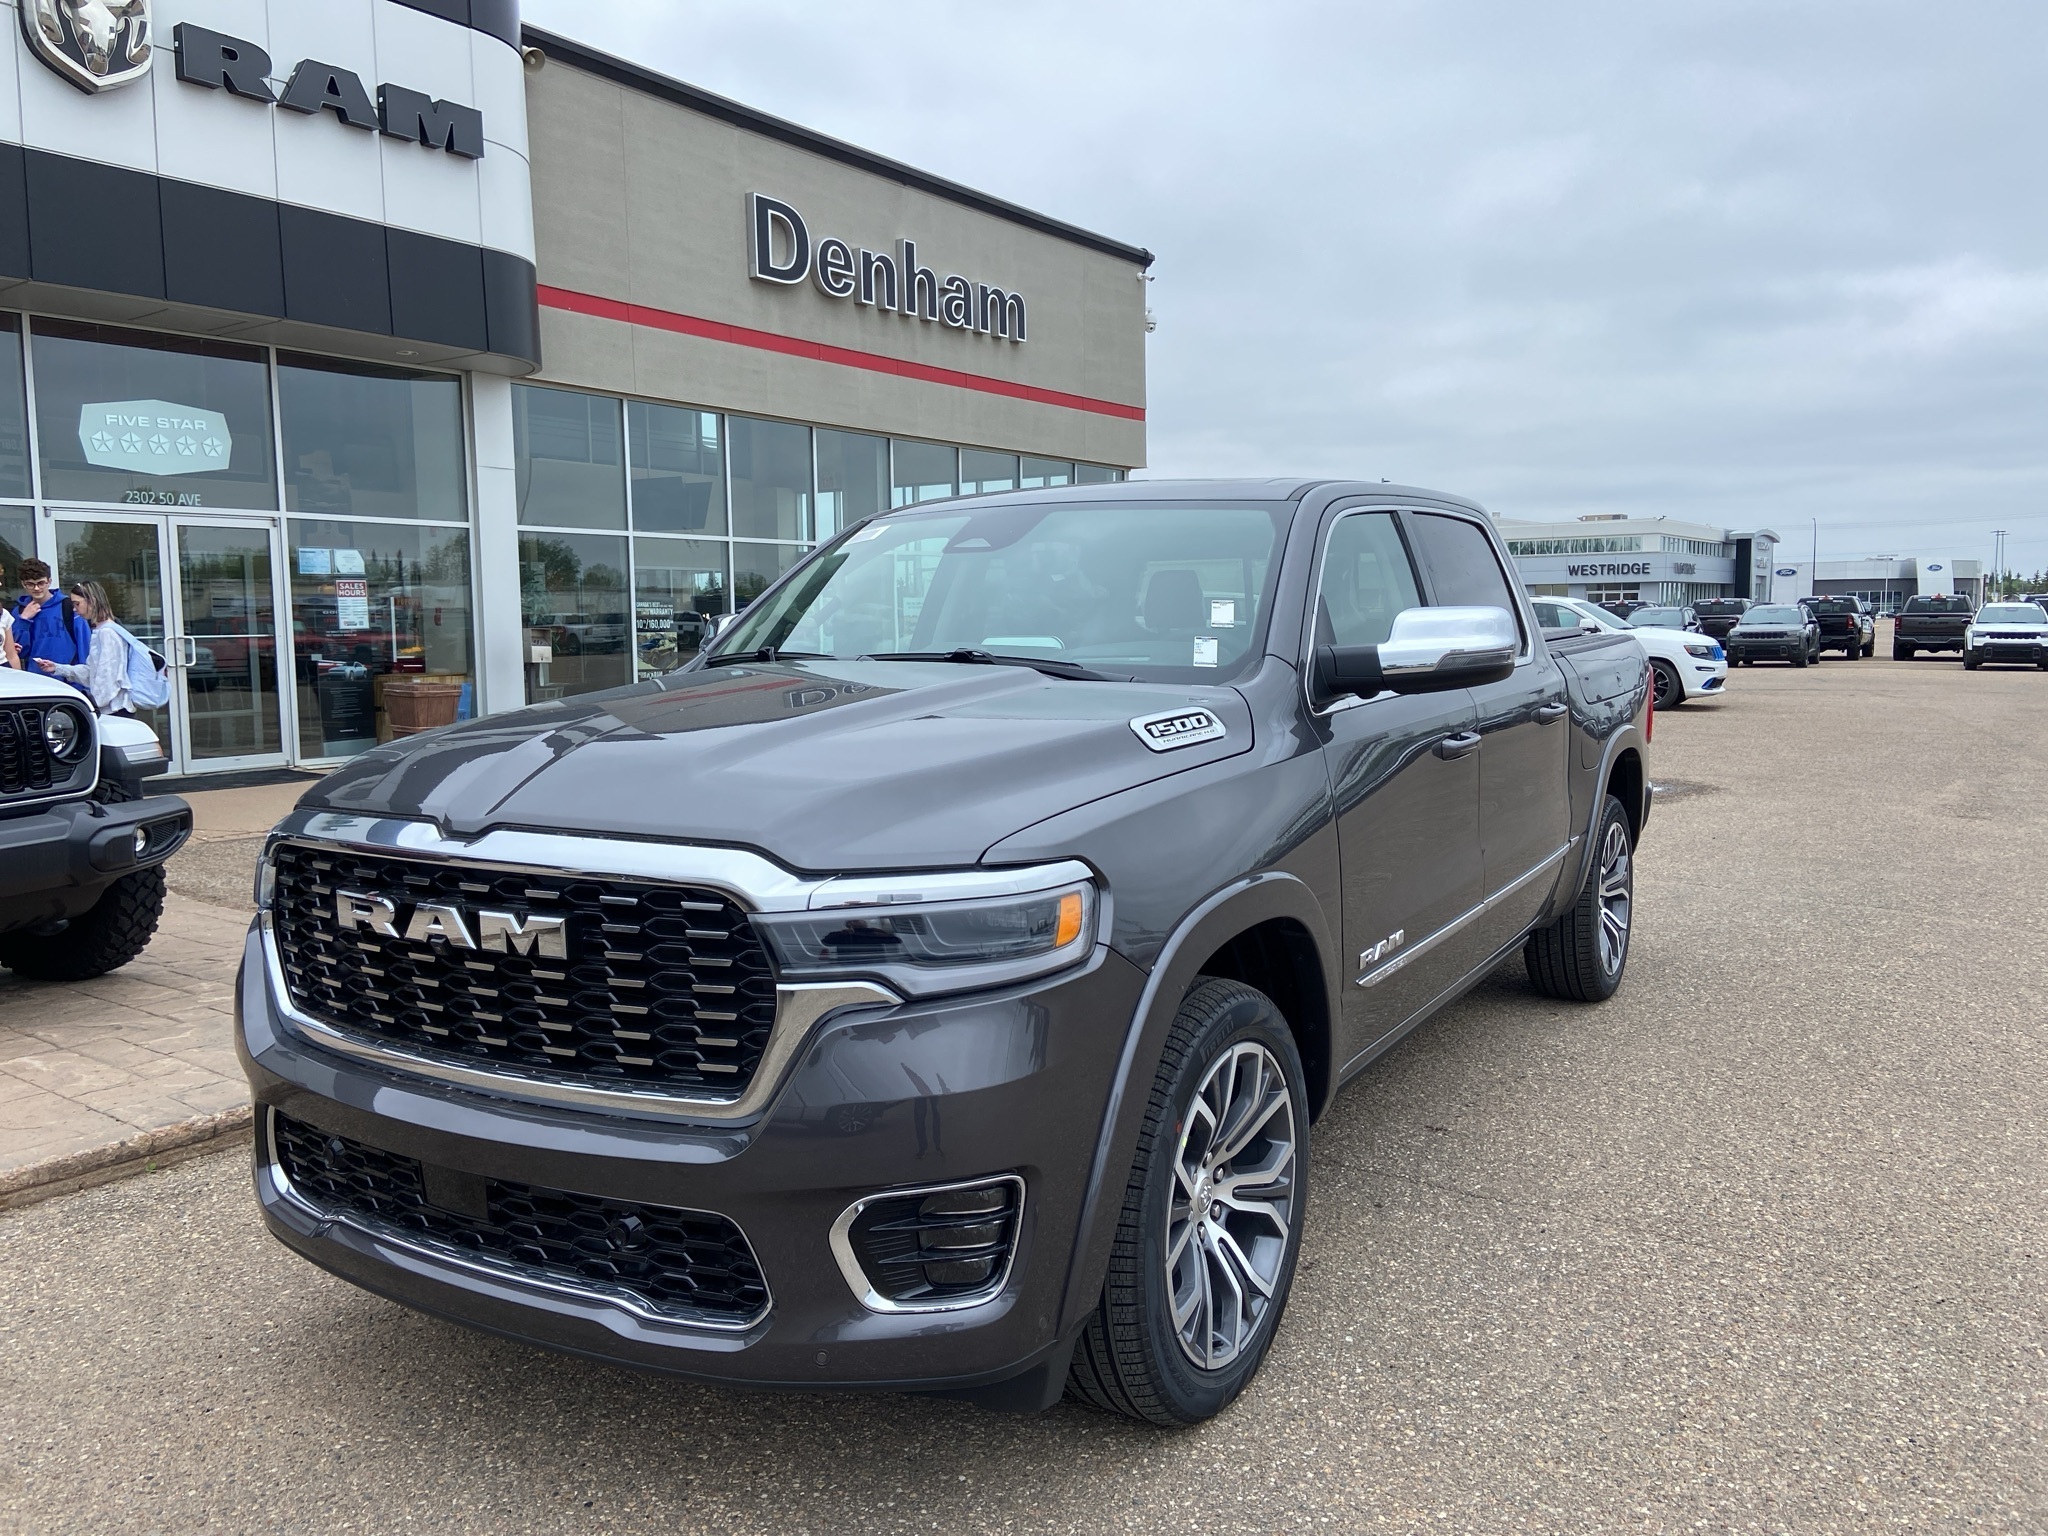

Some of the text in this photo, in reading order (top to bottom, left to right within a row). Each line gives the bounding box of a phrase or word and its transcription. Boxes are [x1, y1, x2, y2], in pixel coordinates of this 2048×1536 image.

[173, 21, 484, 159] RAM
[746, 192, 1027, 343] Denham
[105, 414, 207, 430] FIVE STAR
[125, 490, 202, 506] 2302 50 AVE
[1568, 562, 1651, 576] WESTRIDGE
[339, 582, 364, 590] SALES
[1146, 714, 1208, 737] 1500
[336, 889, 568, 960] RAM
[1359, 929, 1404, 970] RAM
